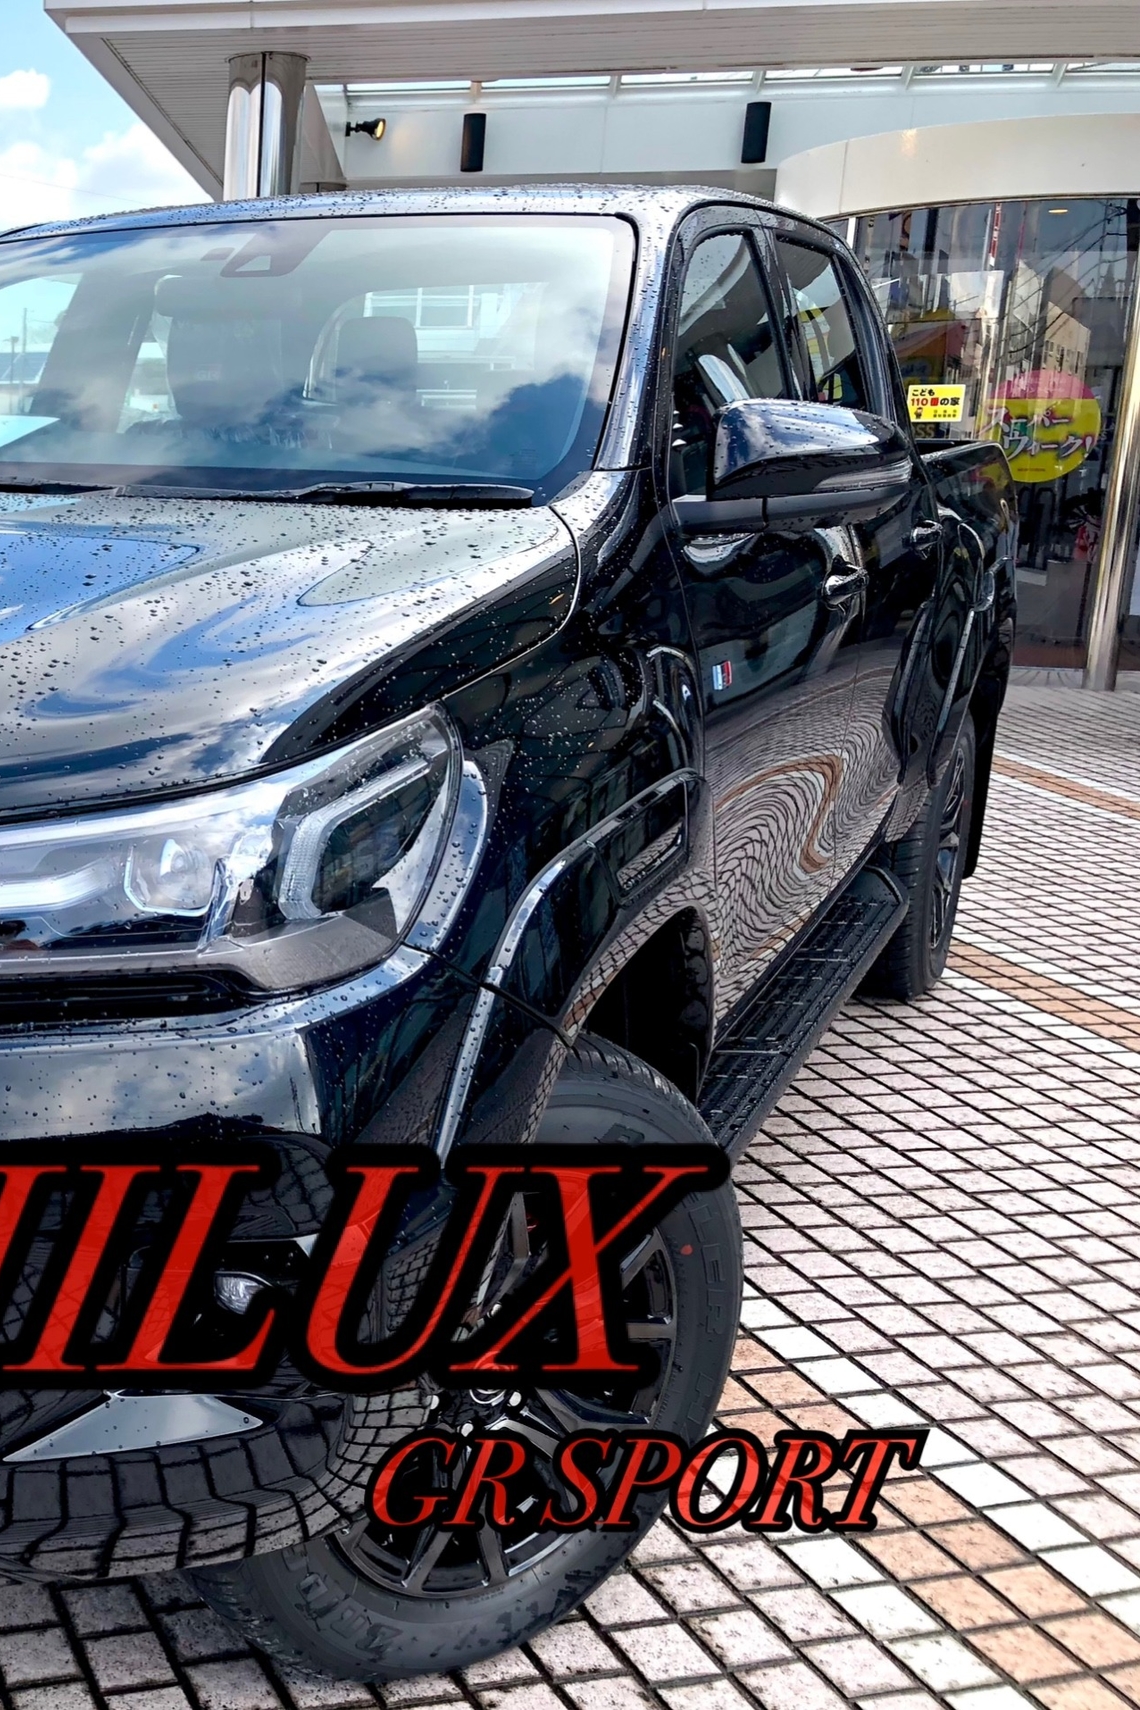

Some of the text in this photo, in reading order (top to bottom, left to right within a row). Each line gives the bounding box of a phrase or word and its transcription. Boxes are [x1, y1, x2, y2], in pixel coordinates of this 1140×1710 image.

[912, 389, 935, 397] こども
[976, 402, 1070, 434] スーパー
